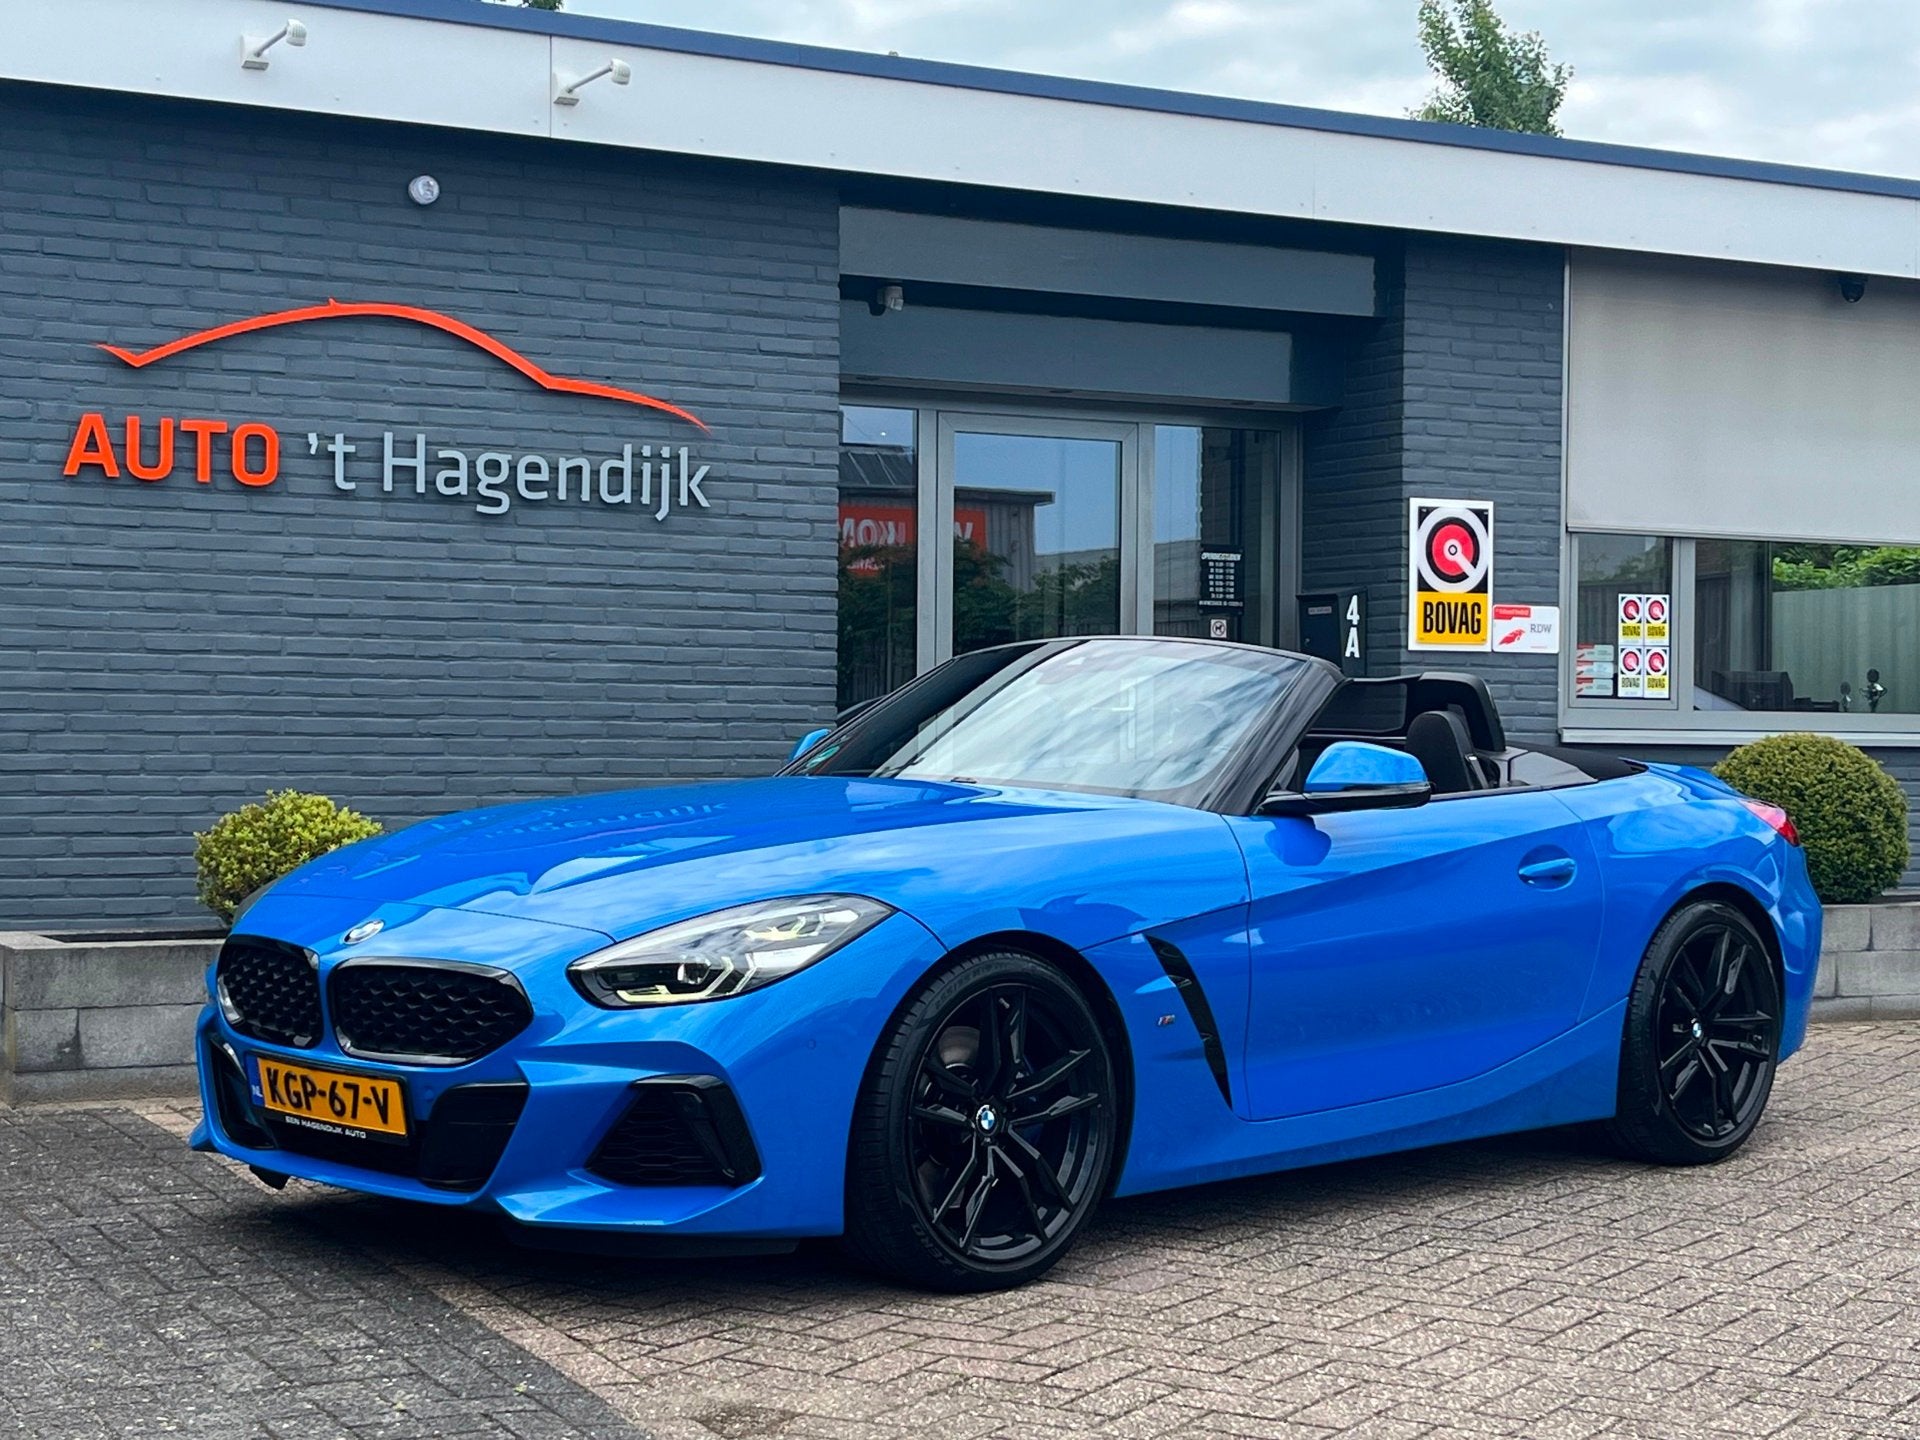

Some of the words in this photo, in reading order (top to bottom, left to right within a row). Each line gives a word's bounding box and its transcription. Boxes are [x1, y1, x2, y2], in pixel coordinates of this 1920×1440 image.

[63, 412, 280, 487] AUTO
[382, 431, 712, 522] Hagendijk
[1423, 601, 1482, 634] BOVAG
[1529, 623, 1553, 634] RDW
[266, 1067, 389, 1125] KGP-67-V
[301, 1119, 344, 1135] HAGENDIJK
[344, 1128, 367, 1139] AUTO
